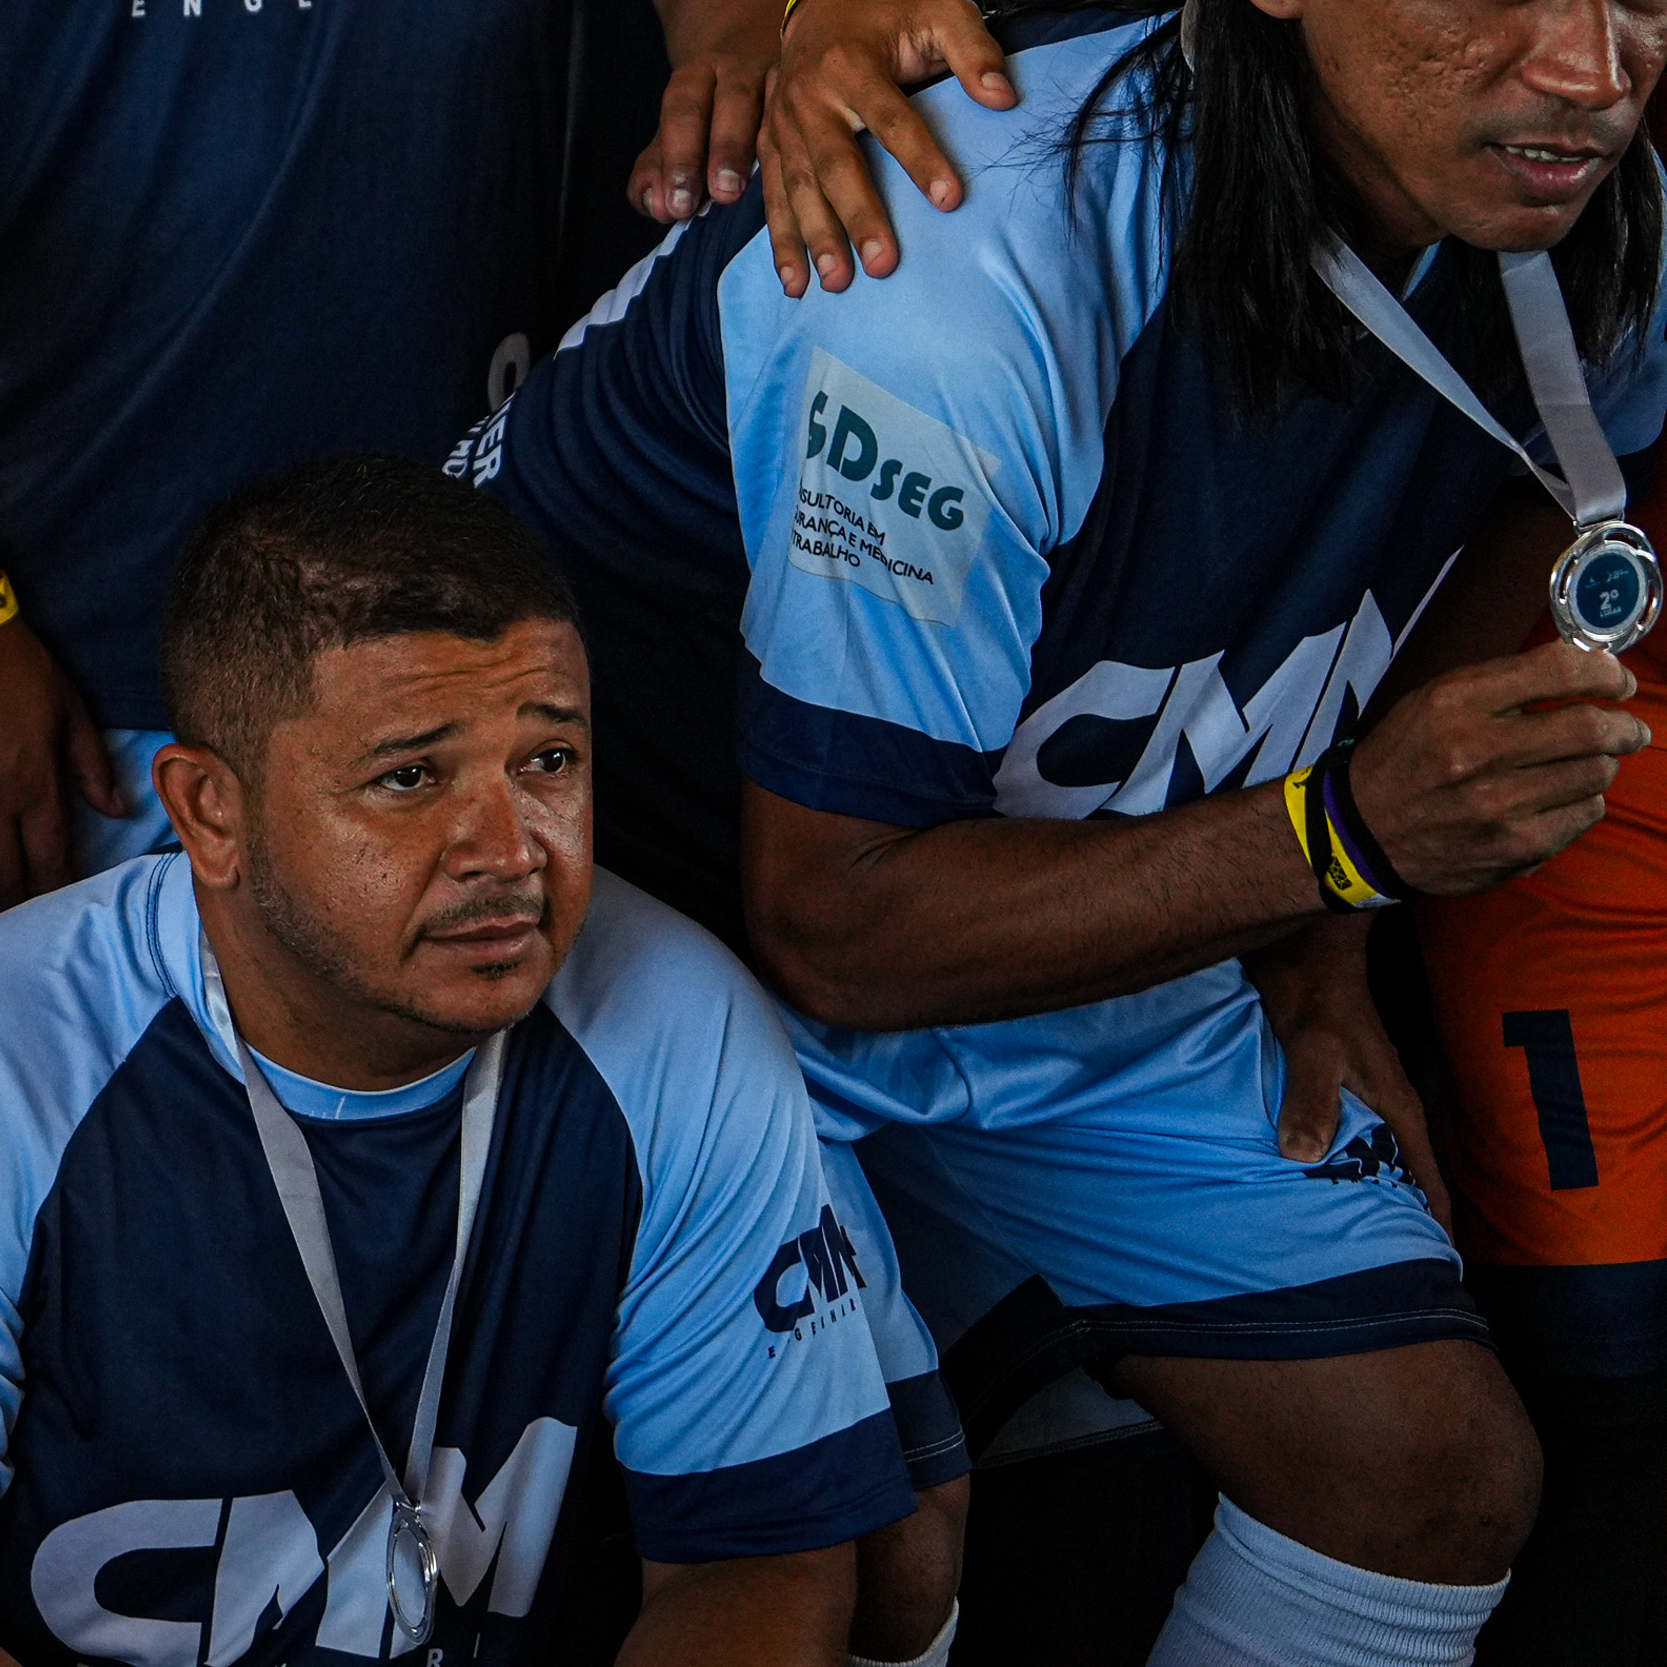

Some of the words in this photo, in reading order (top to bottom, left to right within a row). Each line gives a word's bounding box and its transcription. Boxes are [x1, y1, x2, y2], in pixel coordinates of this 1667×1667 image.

[792, 530, 861, 568] TRABALHO
[866, 523, 886, 546] EM
[849, 532, 857, 547] E
[860, 539, 934, 585] MEDICINA
[1502, 1009, 1599, 1191] 1
